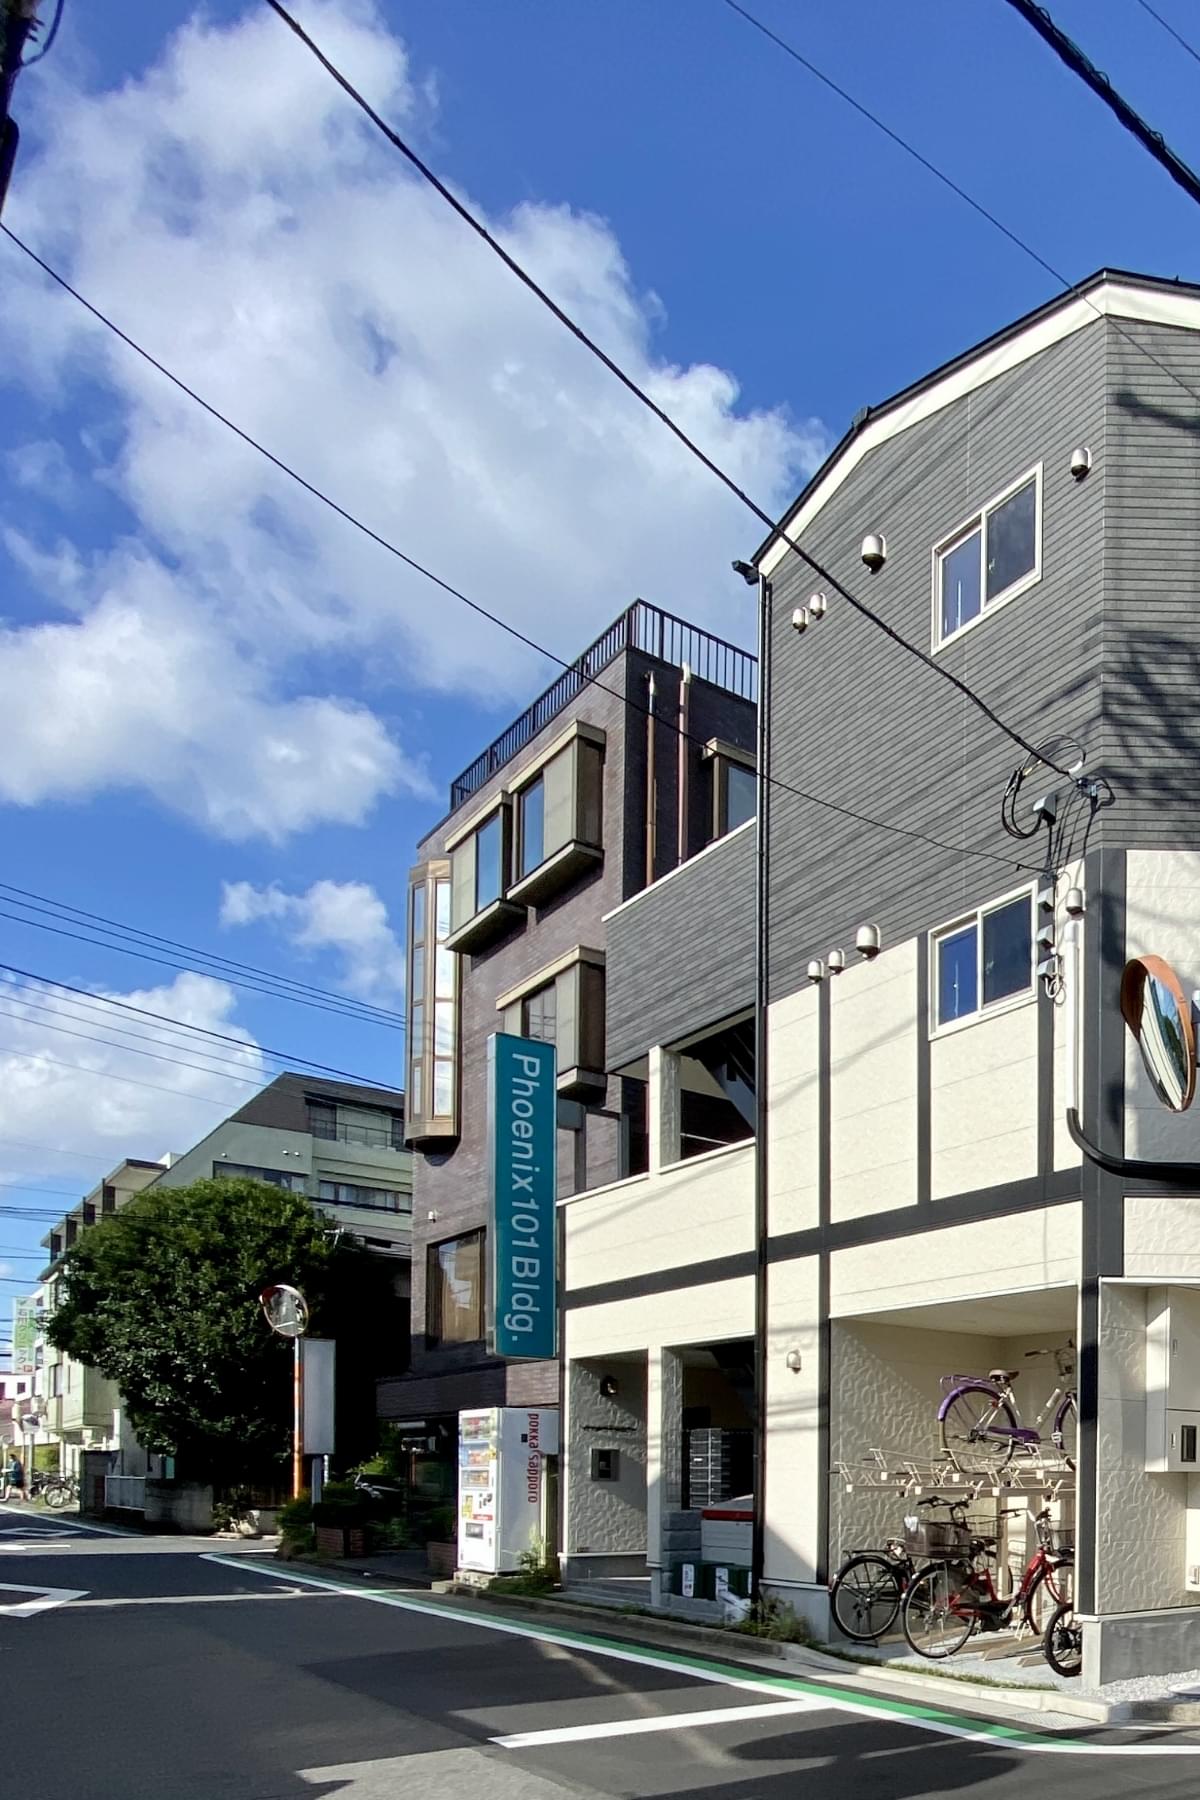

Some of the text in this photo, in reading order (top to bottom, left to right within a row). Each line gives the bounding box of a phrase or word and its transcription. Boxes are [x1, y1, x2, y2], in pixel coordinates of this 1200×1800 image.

[503, 1053, 540, 1342] Phoenix 101 Bldg.
[527, 1455, 539, 1504] sapporo
